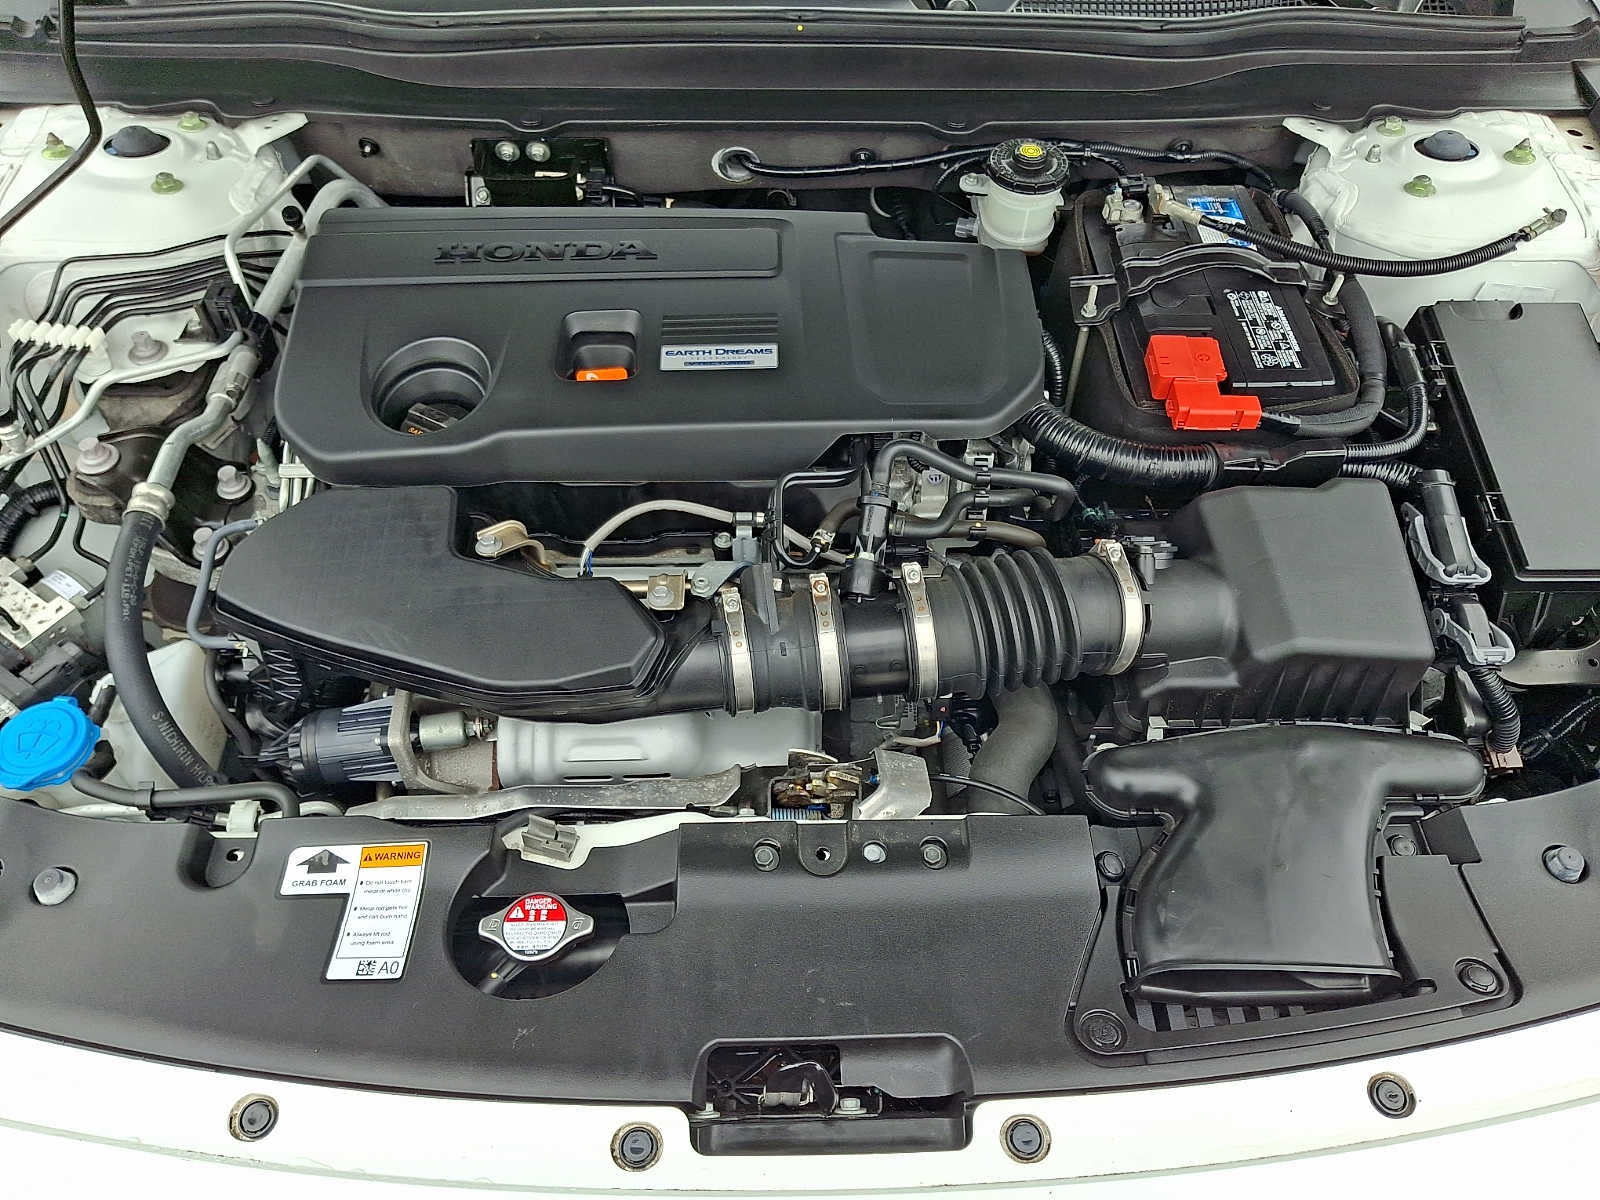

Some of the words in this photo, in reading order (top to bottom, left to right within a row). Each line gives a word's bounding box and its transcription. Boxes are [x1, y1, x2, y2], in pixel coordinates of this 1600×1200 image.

[434, 241, 657, 263] HONDA
[665, 349, 712, 357] EARTH
[715, 348, 774, 356] DREAMS
[374, 851, 421, 862] WARNING
[291, 879, 318, 888] GRAB
[320, 878, 347, 887] FOAM
